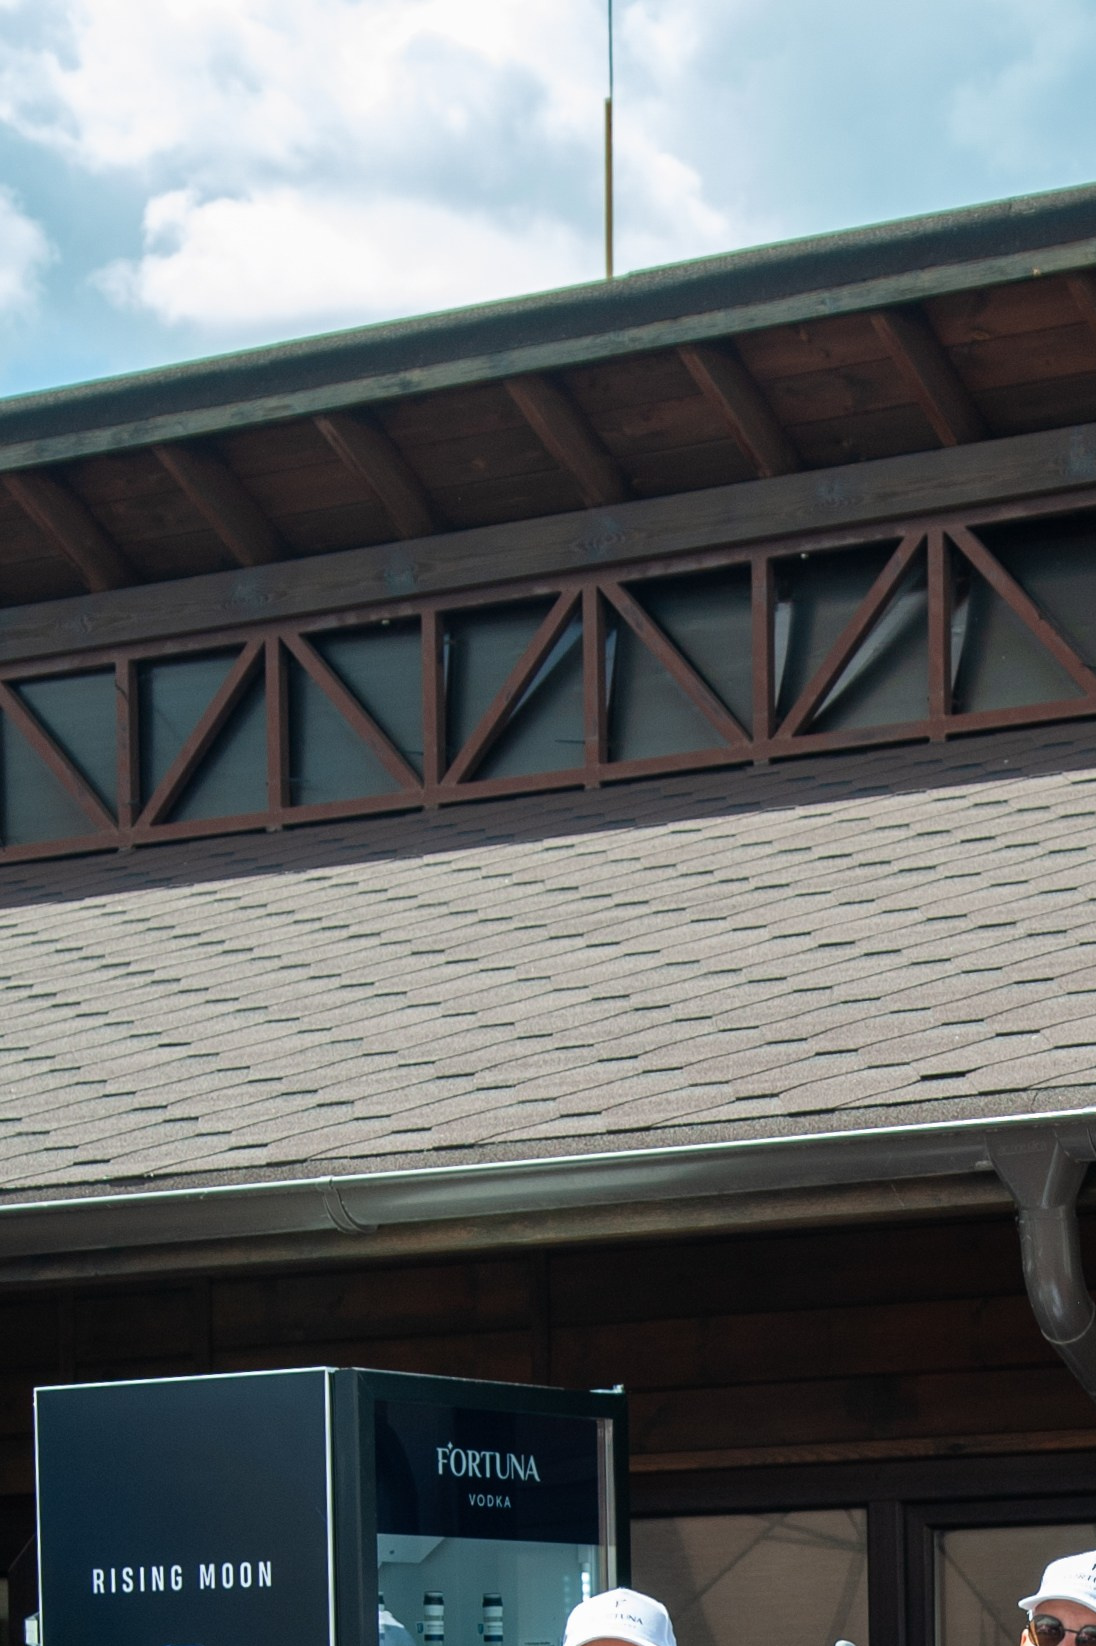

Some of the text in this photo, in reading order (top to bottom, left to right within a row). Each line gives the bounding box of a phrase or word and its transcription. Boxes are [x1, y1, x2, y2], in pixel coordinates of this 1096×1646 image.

[436, 1442, 541, 1482] FORTUNA
[469, 1494, 511, 1509] VODKA
[92, 1561, 273, 1594] RISING MOON
